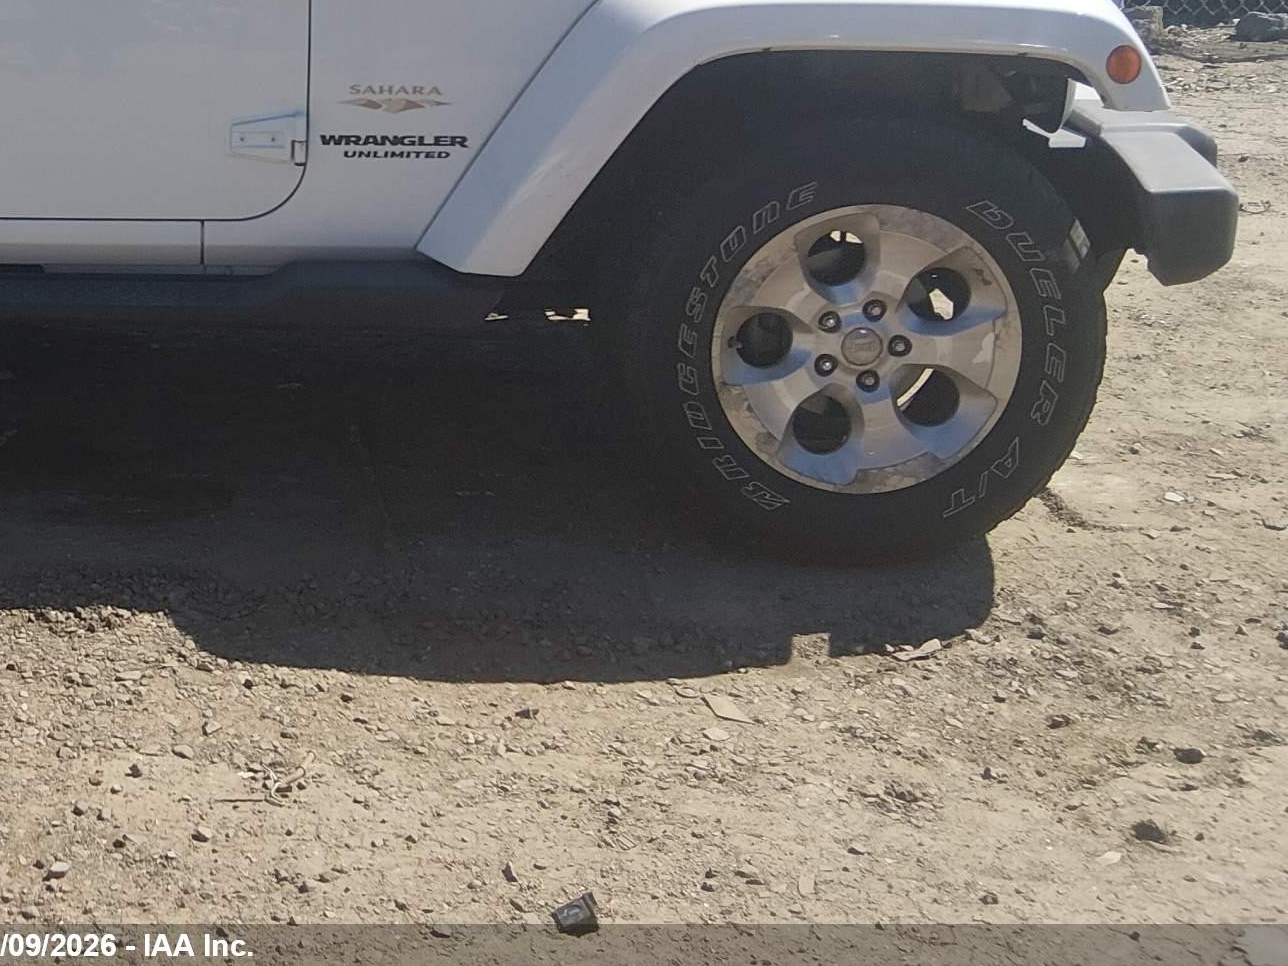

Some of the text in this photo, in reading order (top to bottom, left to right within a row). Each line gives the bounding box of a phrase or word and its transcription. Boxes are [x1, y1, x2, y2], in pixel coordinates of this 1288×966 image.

[349, 84, 443, 96] SAHARA
[320, 134, 469, 148] WRANGLER
[343, 150, 451, 159] UNLIMITED
[677, 181, 818, 511] BRIDGESTONE
[941, 199, 1067, 519] DUELER A/T
